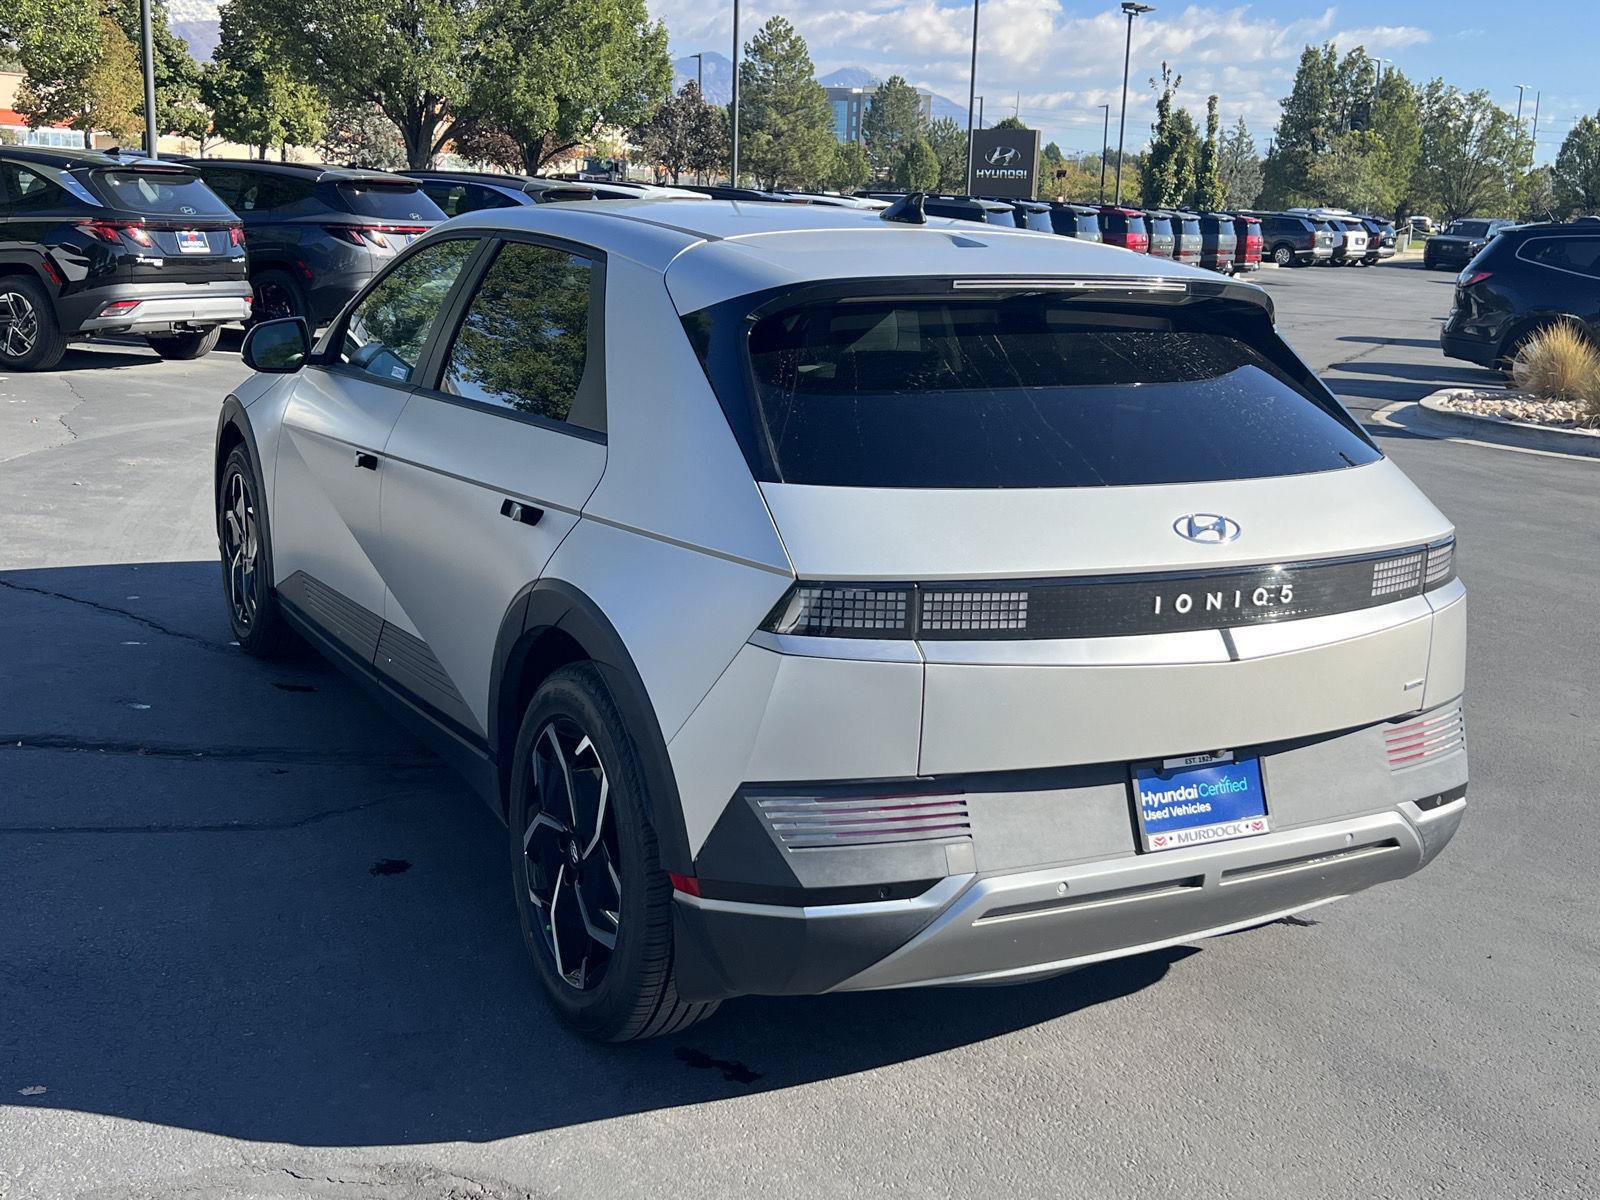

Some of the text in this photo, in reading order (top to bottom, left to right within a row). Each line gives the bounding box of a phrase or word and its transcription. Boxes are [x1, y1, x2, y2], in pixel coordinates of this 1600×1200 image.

[976, 169, 1027, 179] HYUNDAI
[1141, 775, 1248, 807] Hyundai Certified
[1143, 802, 1212, 821] Used Vehicles
[1178, 824, 1243, 843] MURDOCK
